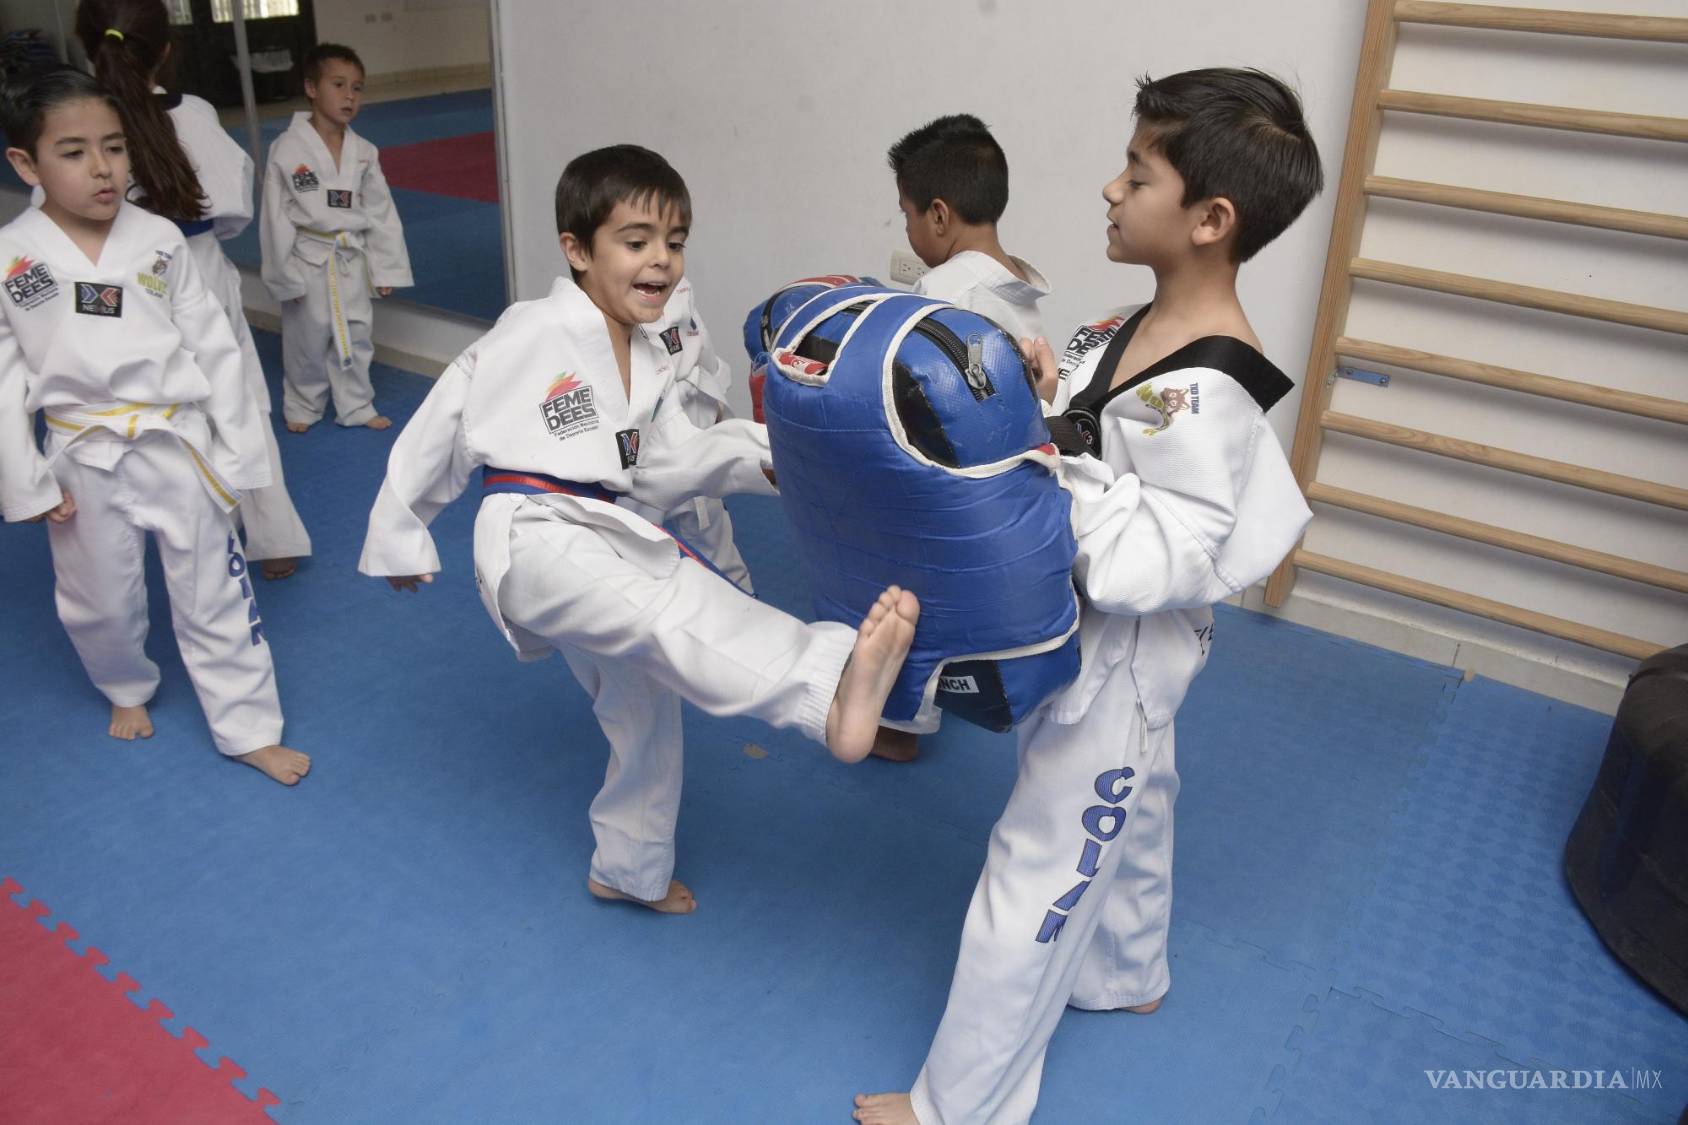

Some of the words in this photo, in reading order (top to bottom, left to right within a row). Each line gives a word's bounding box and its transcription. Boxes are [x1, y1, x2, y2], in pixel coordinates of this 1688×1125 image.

[5, 263, 48, 292] FEME
[11, 275, 54, 304] DEES
[542, 388, 592, 418] FEME
[546, 402, 597, 431] DEES
